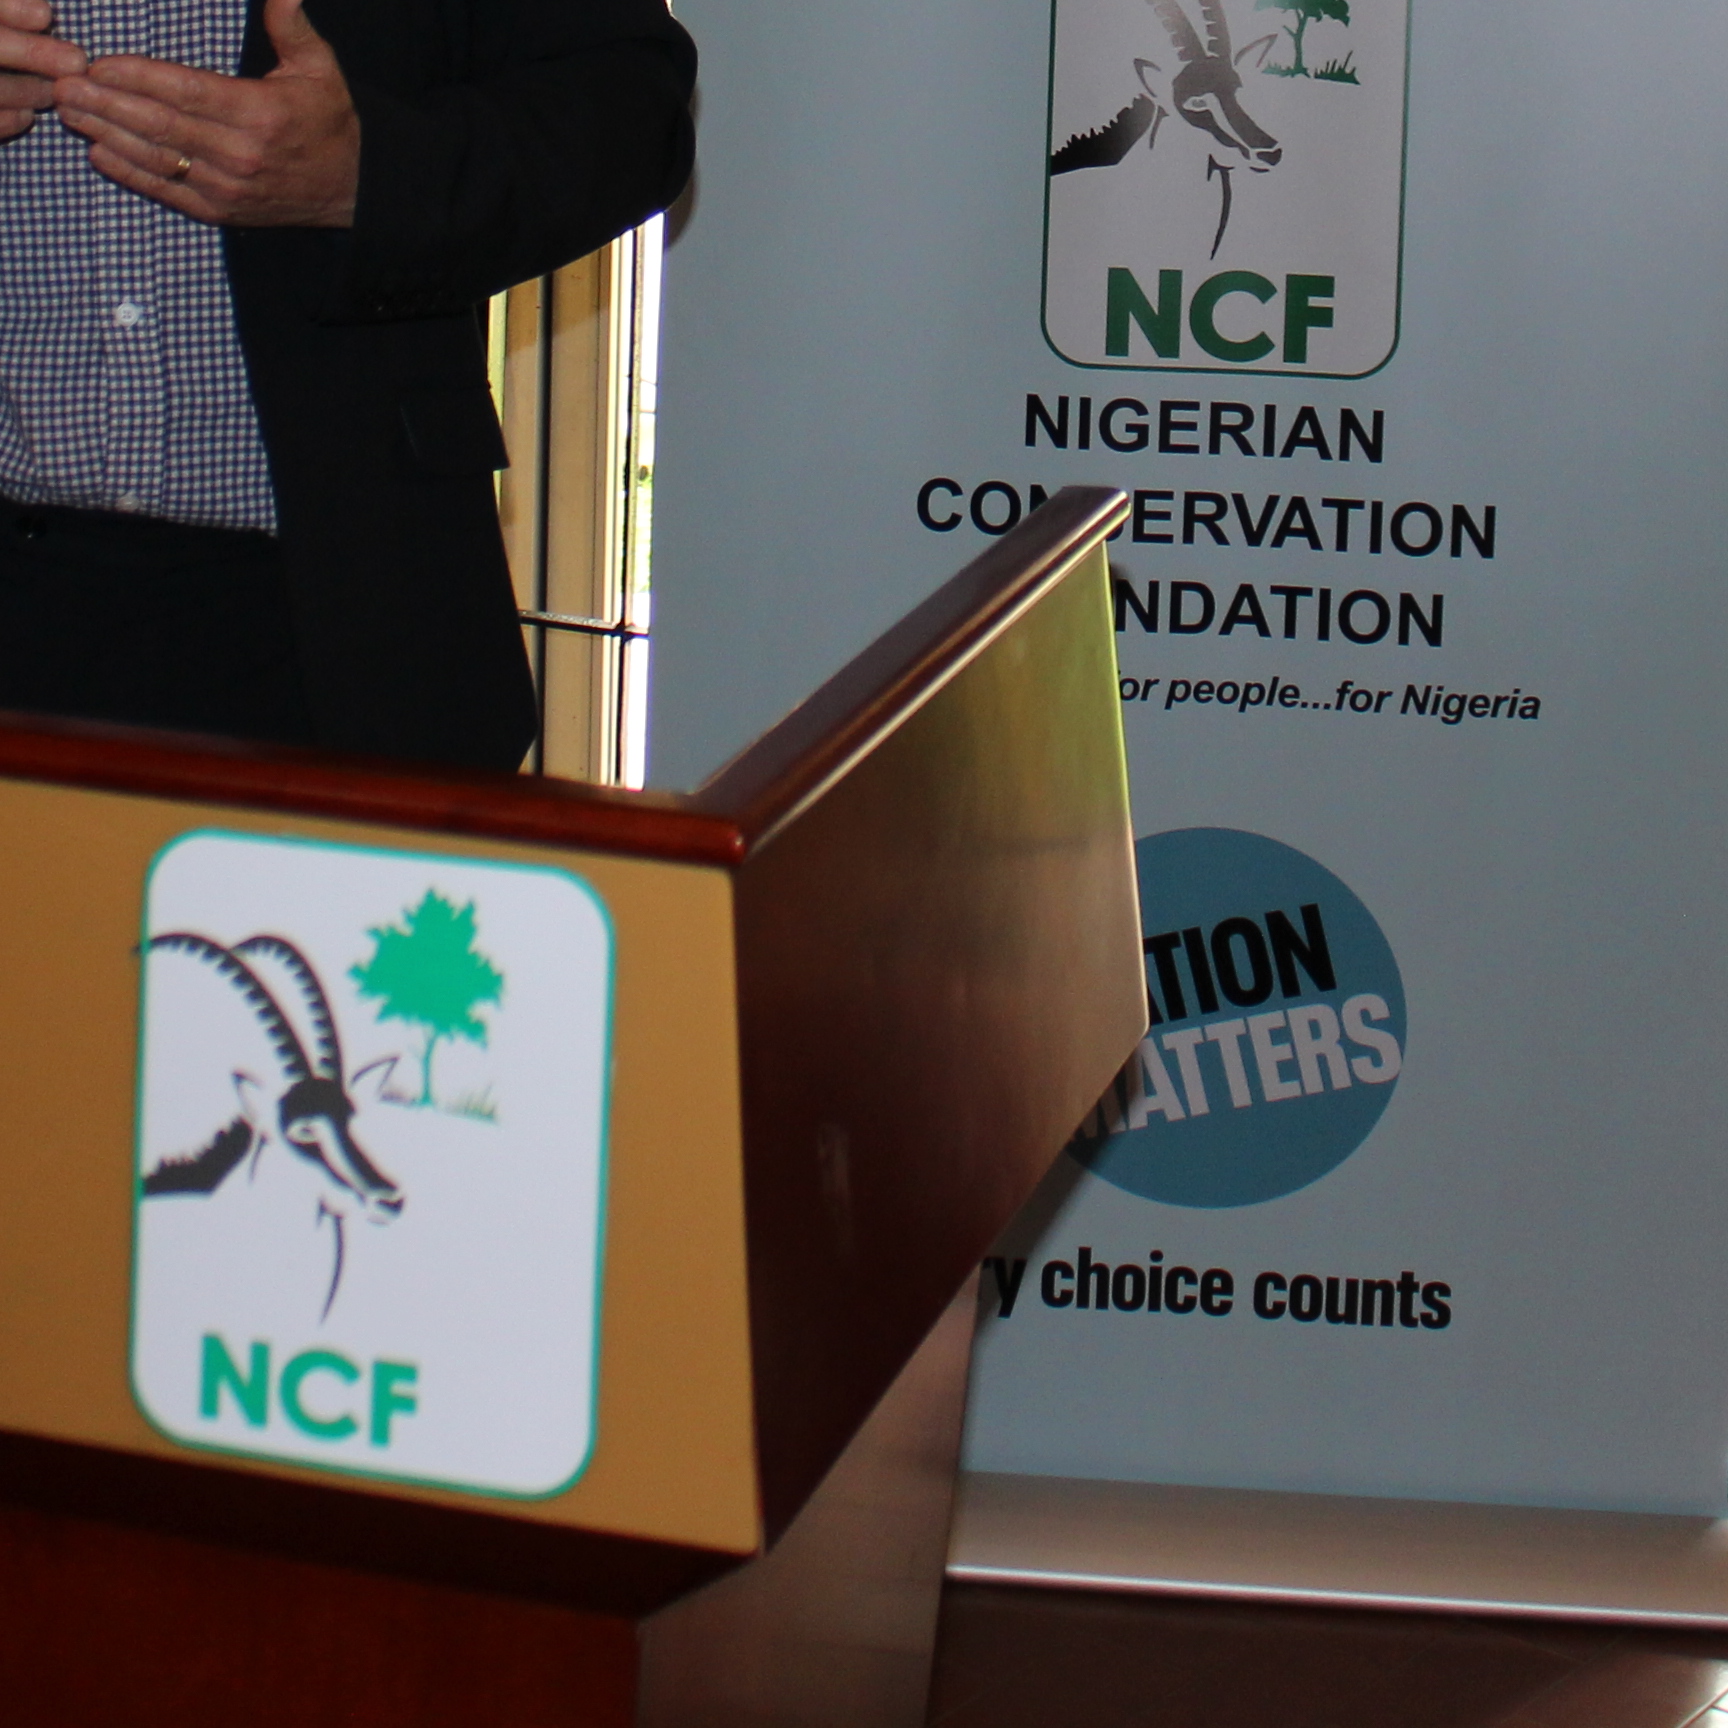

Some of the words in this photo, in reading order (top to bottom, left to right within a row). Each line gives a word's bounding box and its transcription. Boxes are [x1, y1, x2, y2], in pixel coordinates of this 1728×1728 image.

[1105, 267, 1335, 365] NCF
[1023, 393, 1385, 464] NIGERIAN
[916, 477, 1498, 560] COERVATION
[1115, 578, 1446, 648] NDATION
[1118, 674, 1160, 703] or
[1401, 685, 1542, 726] Nigeria
[1143, 903, 1337, 1026] TION
[1040, 1246, 1234, 1316] choice
[1253, 1270, 1453, 1330] counts
[198, 1332, 419, 1448] NCF
